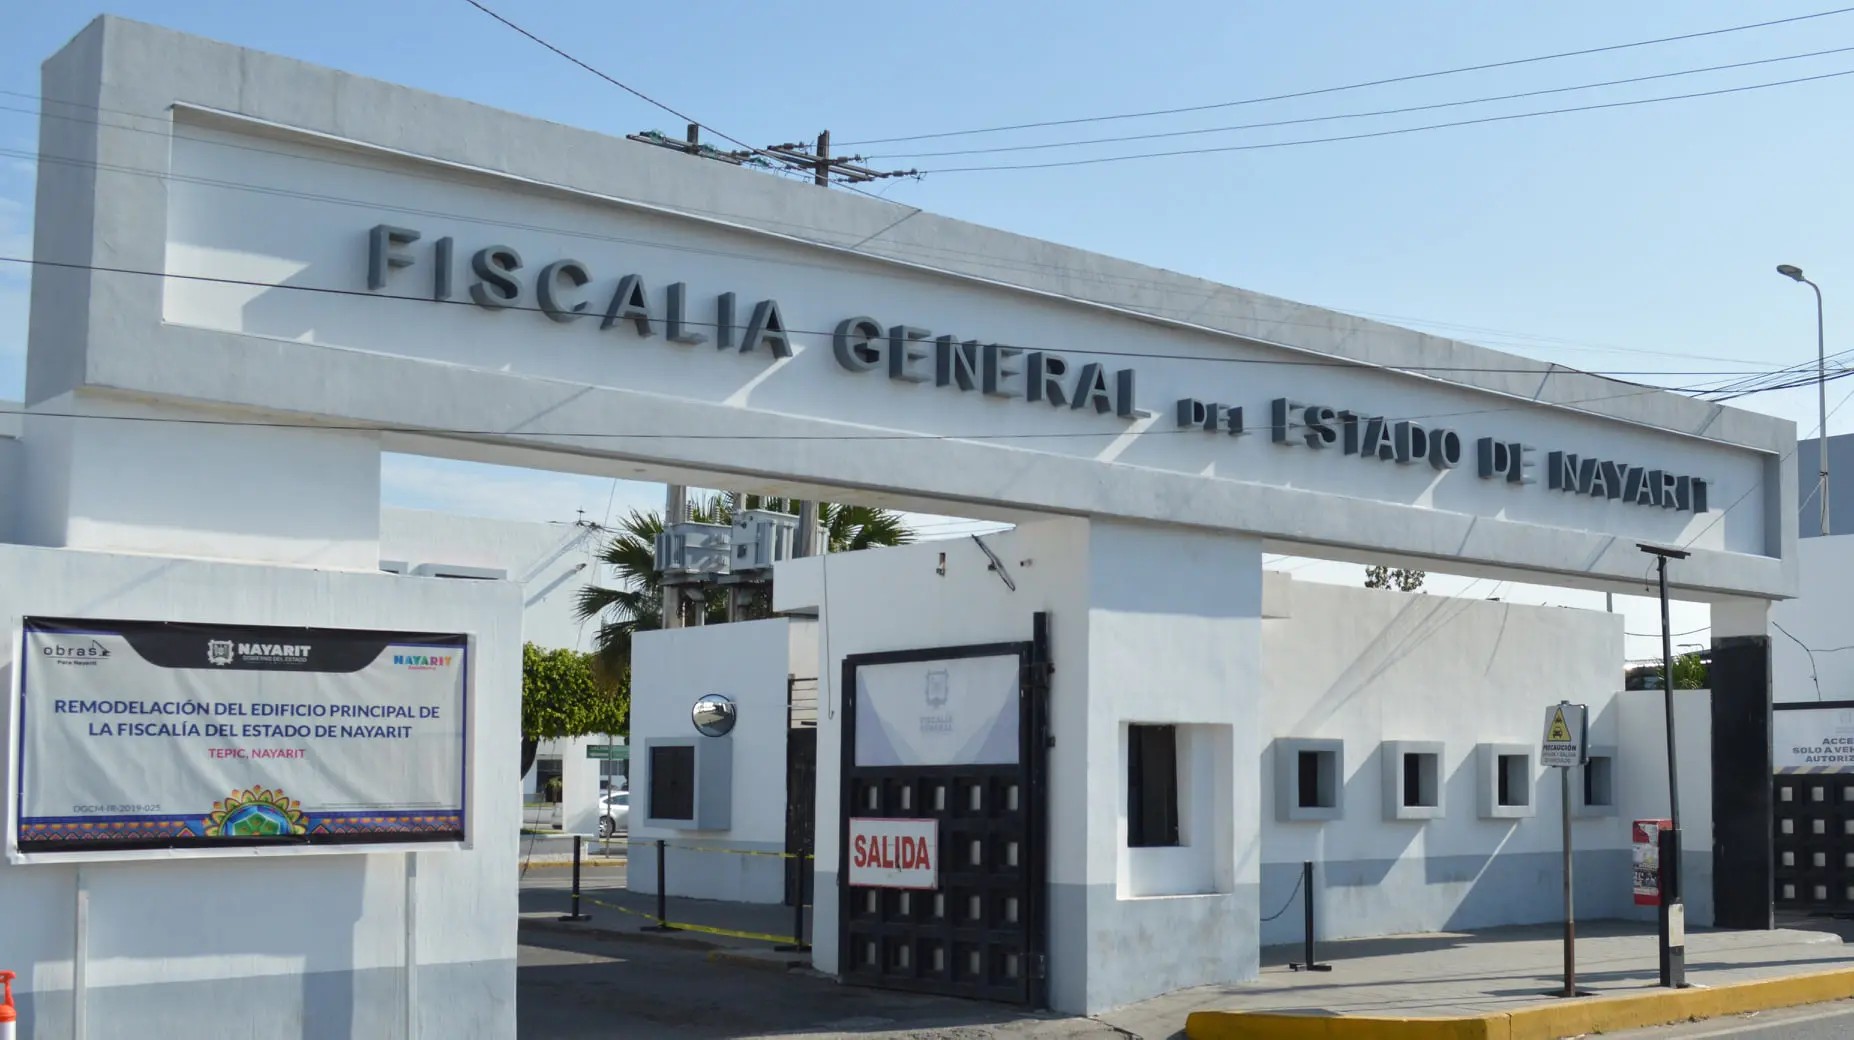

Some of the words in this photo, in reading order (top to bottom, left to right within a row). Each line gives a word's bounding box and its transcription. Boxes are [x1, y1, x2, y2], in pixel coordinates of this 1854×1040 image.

[367, 223, 793, 360] FISCALIA
[832, 315, 1152, 420] GENERAL
[1176, 397, 1251, 437] DEL
[1271, 396, 1463, 472] ESTADO
[1477, 435, 1538, 485] DE
[1548, 449, 1714, 515] NAYARIT
[43, 644, 97, 657] obras
[238, 643, 311, 657] NAYARIT
[393, 655, 452, 666] NAYARIT
[55, 700, 209, 715] REMODELACIÓN
[214, 702, 247, 716] DEL
[251, 703, 326, 717] EDIFICIO
[330, 704, 415, 718] PRINCIPAL
[419, 706, 440, 718] DE
[89, 723, 113, 736] LA
[117, 721, 201, 737] FISCALÍA
[205, 723, 238, 737] DEL
[242, 724, 311, 738] ESTADO
[315, 724, 337, 738] DE
[340, 725, 412, 739] NAYARIT
[208, 748, 249, 760] TEPIC,
[251, 748, 306, 759] NAYARIT
[854, 835, 931, 870] SALIDA
